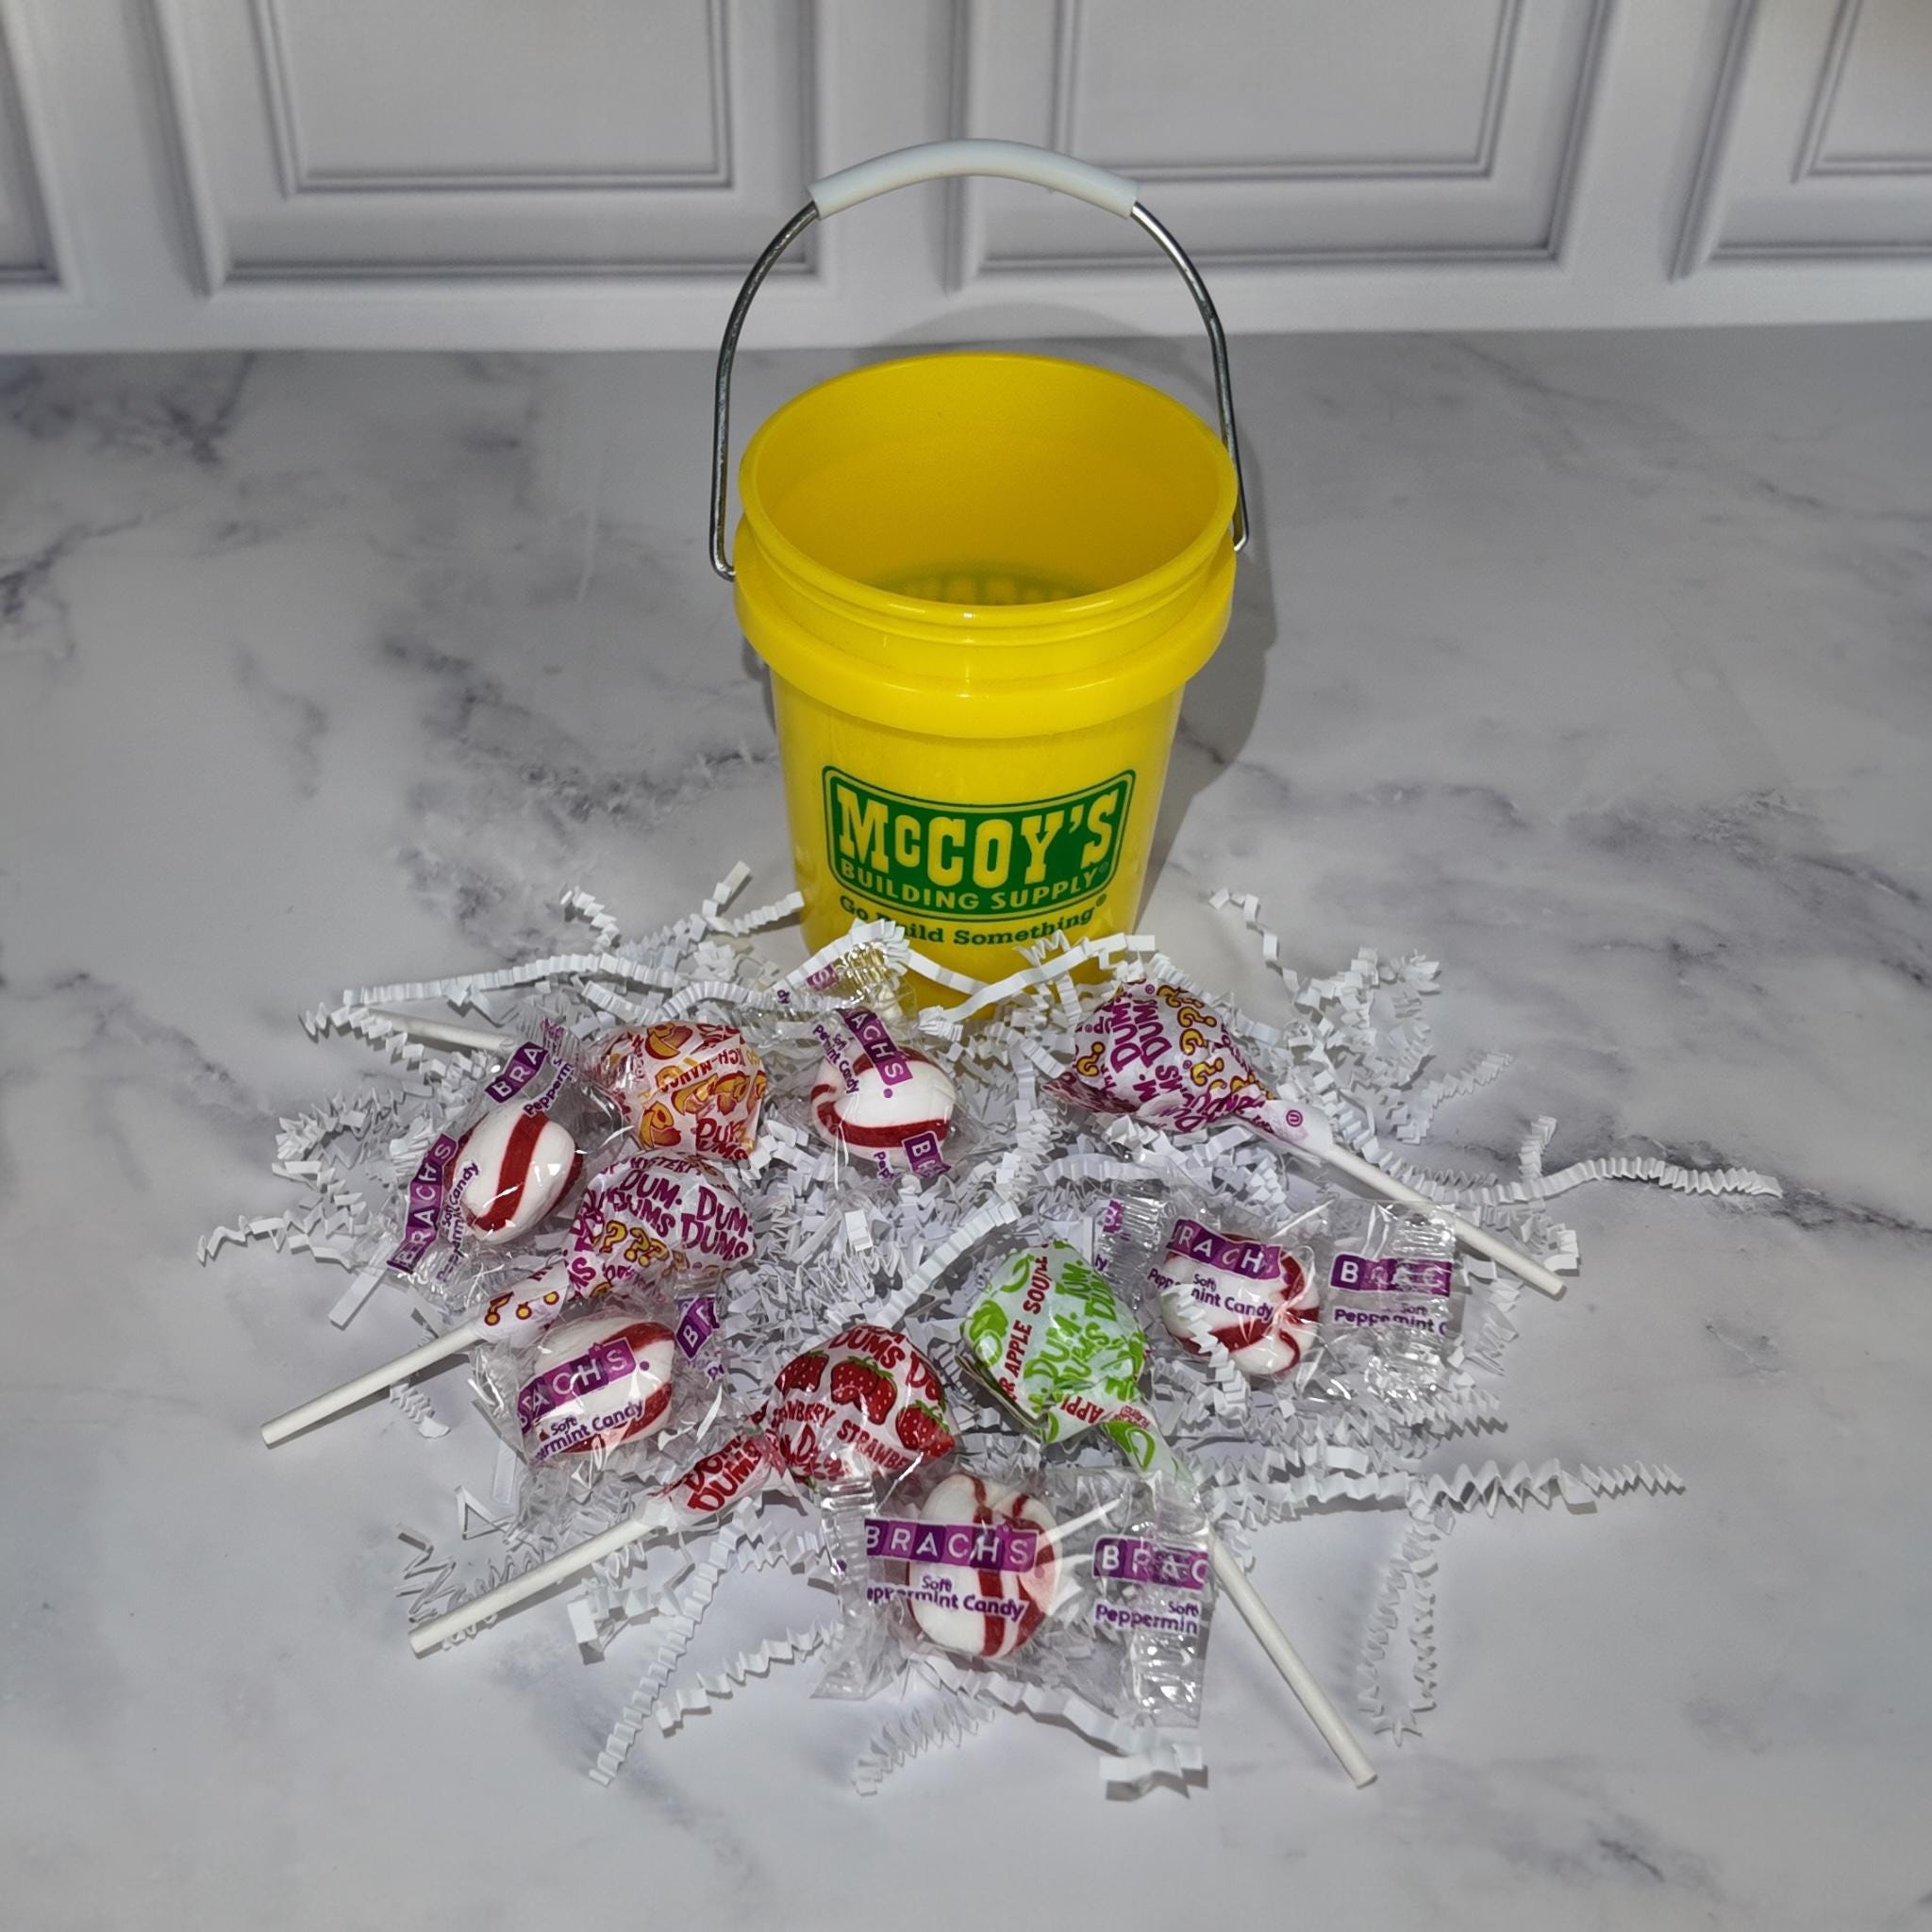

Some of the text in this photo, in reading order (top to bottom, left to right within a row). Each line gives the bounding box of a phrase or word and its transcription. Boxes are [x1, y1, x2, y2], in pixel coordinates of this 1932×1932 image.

[840, 858, 980, 911] BUILDING
[840, 894, 869, 922] Go
[680, 1212, 749, 1261] DUMS
[1224, 1296, 1274, 1321] Candy
[1005, 1320, 1032, 1378] APPLE
[550, 1415, 578, 1435] Soft
[591, 1399, 643, 1431] Candy
[963, 1594, 1024, 1622] Candy
